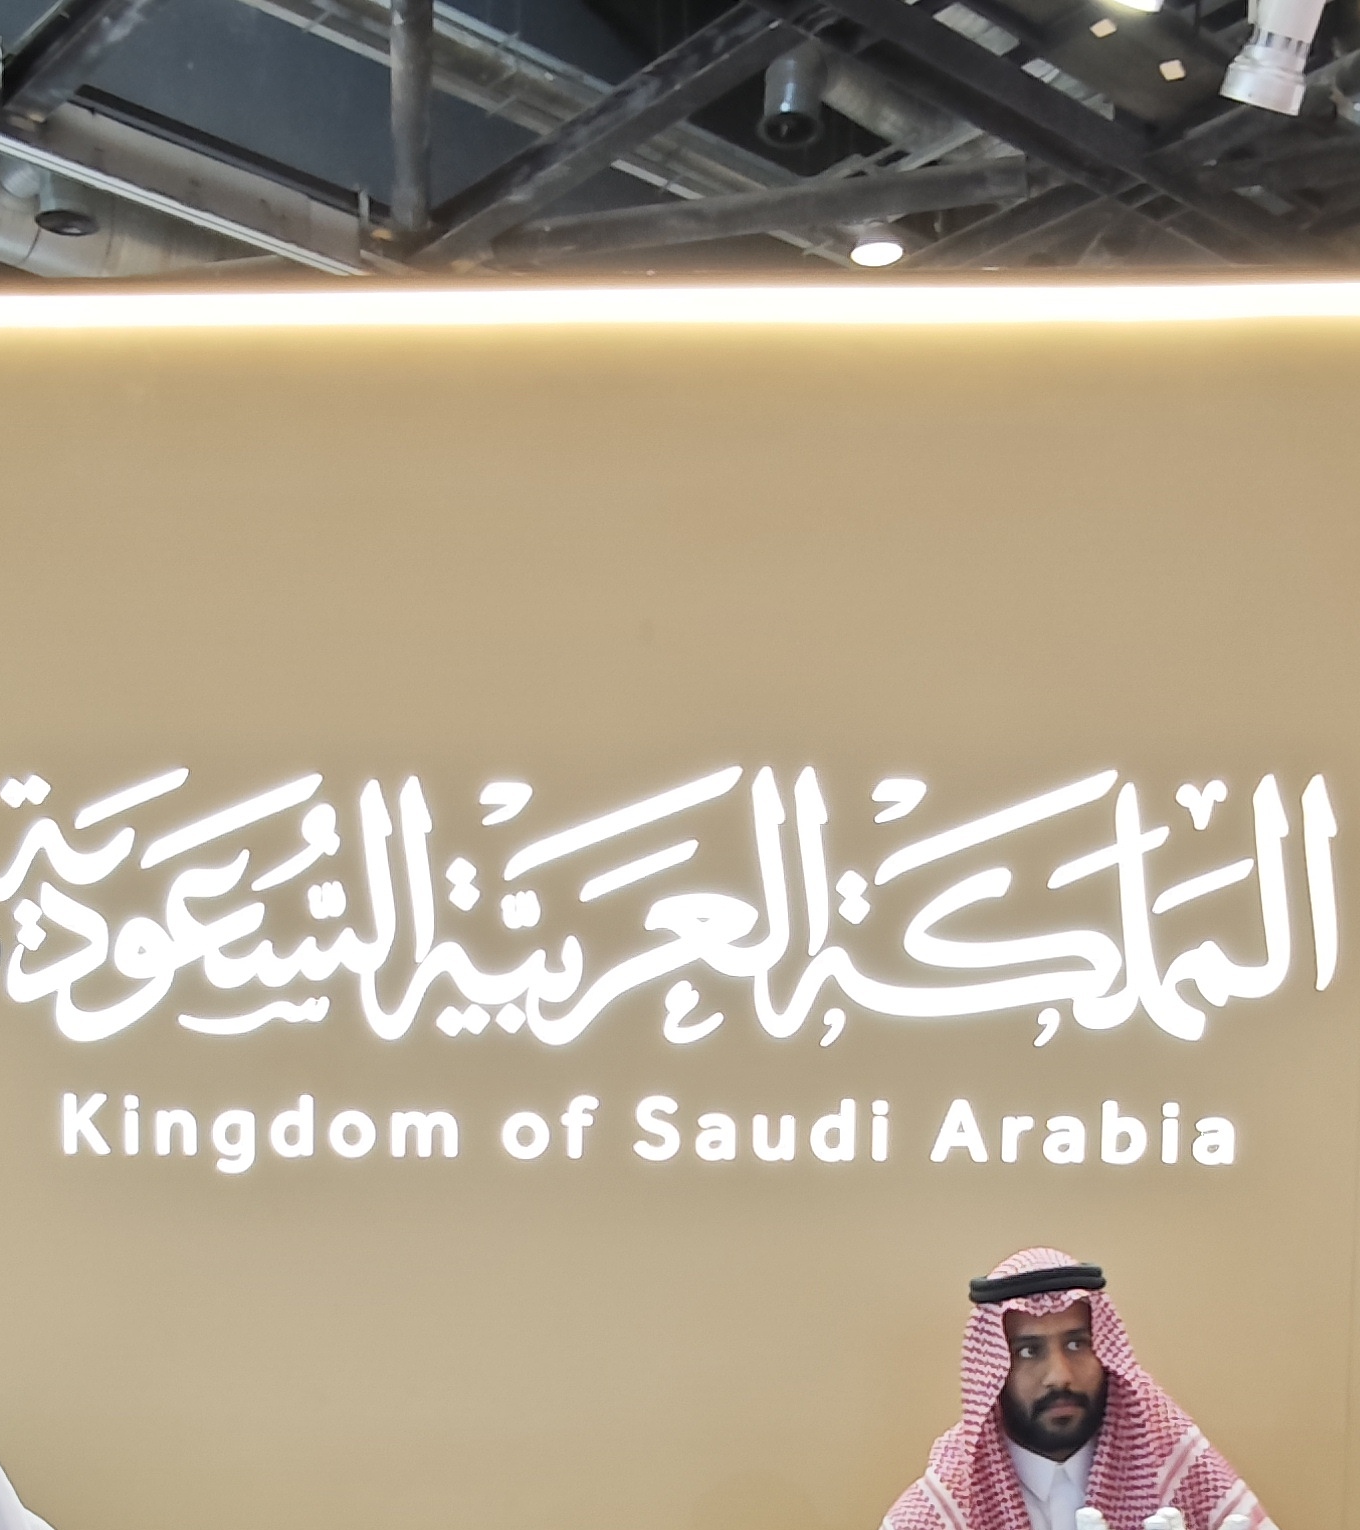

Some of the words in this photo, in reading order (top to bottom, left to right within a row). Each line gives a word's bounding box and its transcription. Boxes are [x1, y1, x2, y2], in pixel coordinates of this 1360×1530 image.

[62, 1092, 459, 1175] Kingdom
[501, 1093, 600, 1161] of
[632, 1094, 890, 1164] Saudi
[929, 1098, 1237, 1167] Arabia
